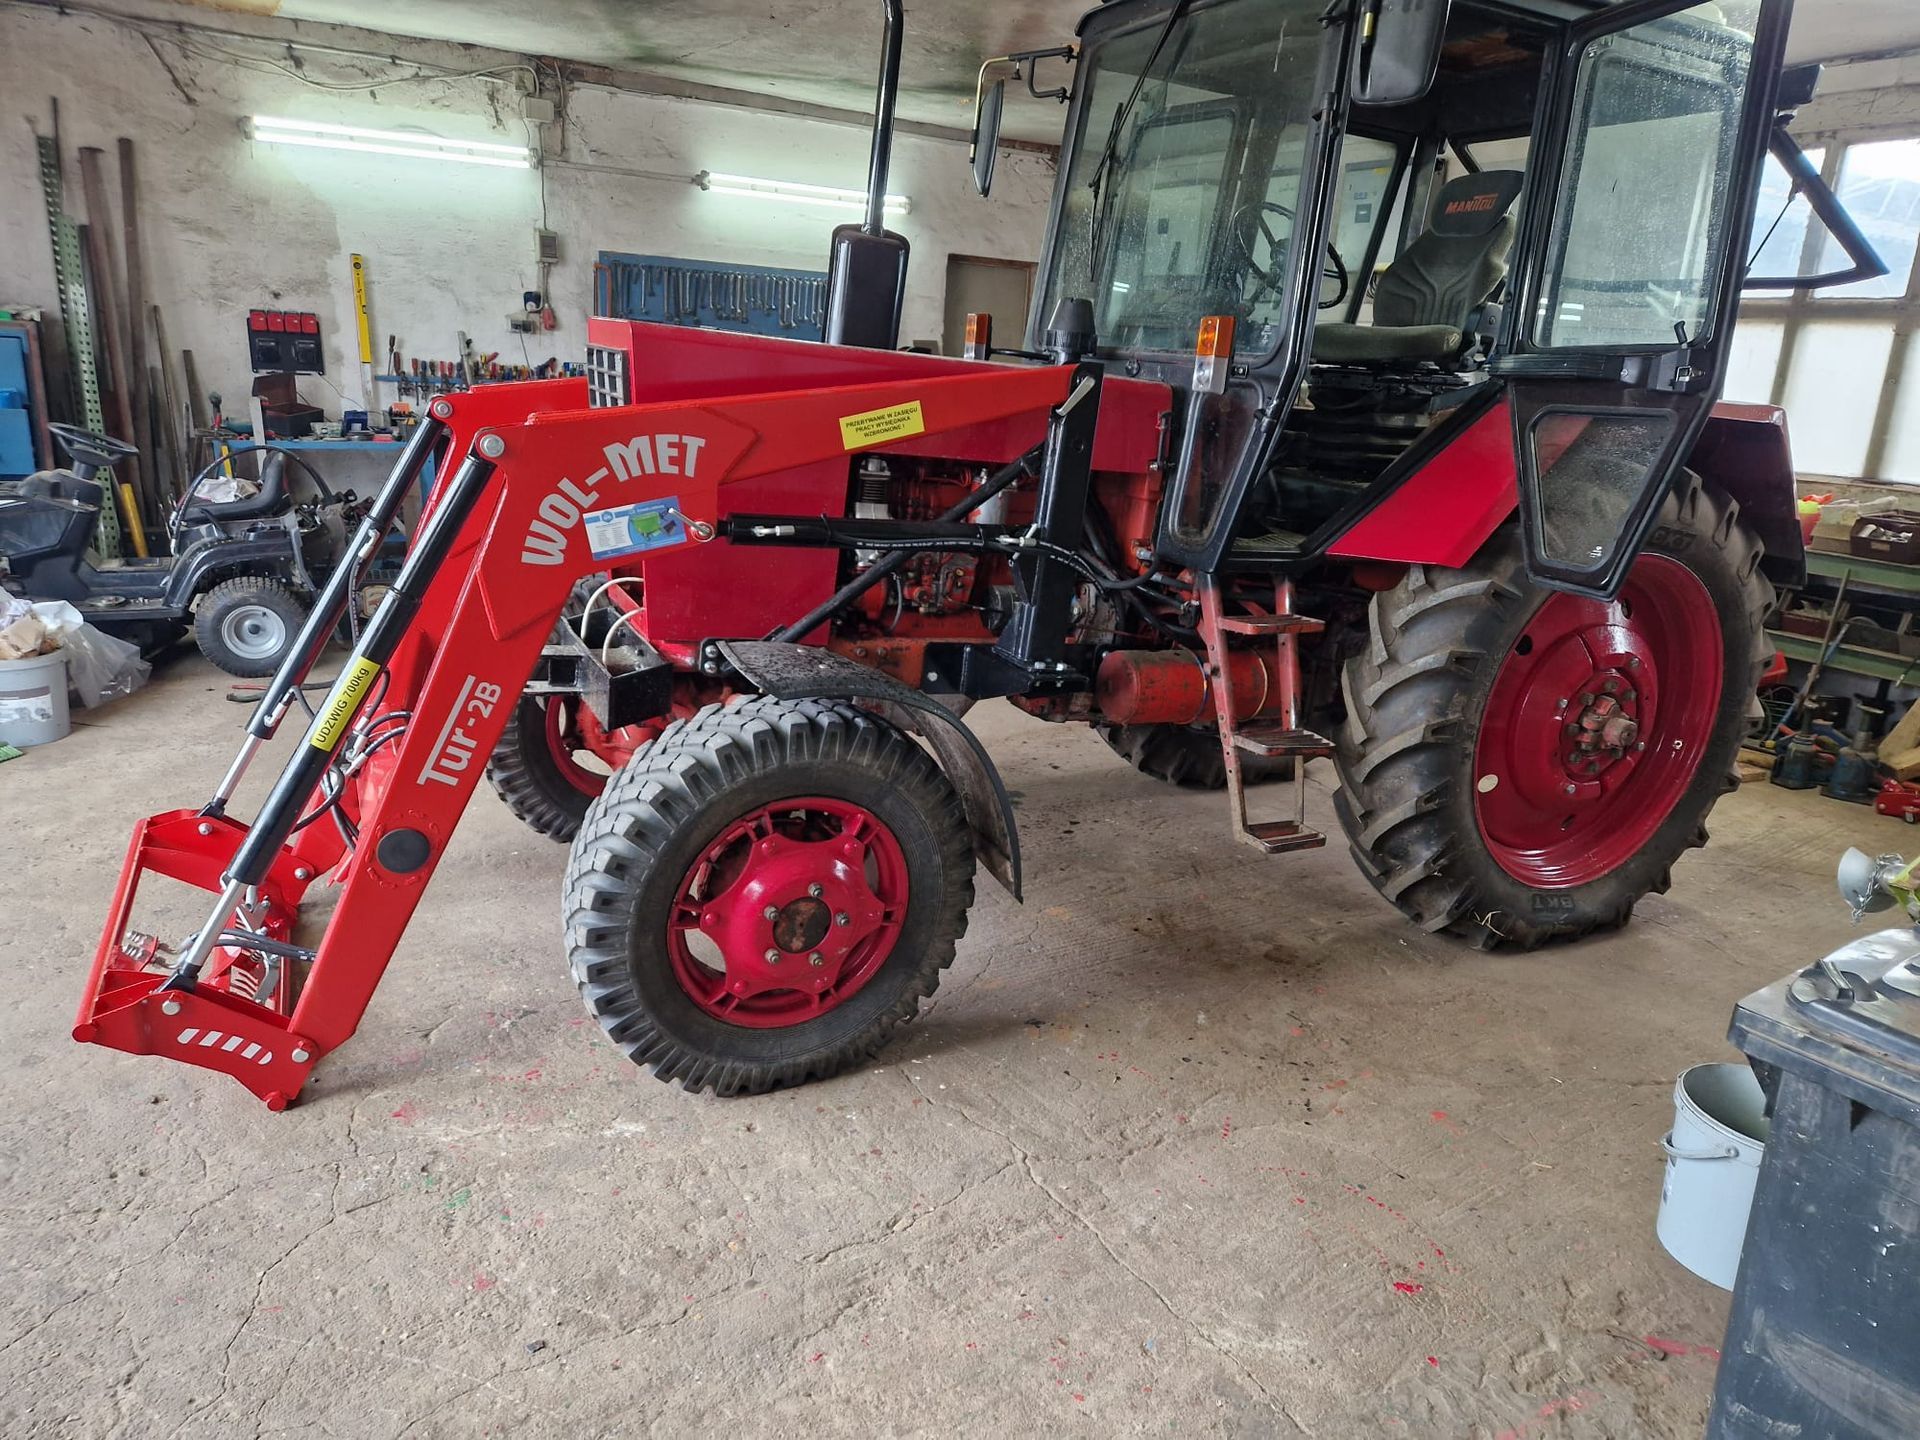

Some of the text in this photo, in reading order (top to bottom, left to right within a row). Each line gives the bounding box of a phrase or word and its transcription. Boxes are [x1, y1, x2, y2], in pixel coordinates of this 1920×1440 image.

[1445, 193, 1498, 215] MANITOU
[887, 412, 893, 420] W
[855, 425, 875, 433] PRACY
[521, 434, 706, 566] WOL-MET
[343, 667, 370, 699] 700kg
[1534, 897, 1574, 909] BKT
